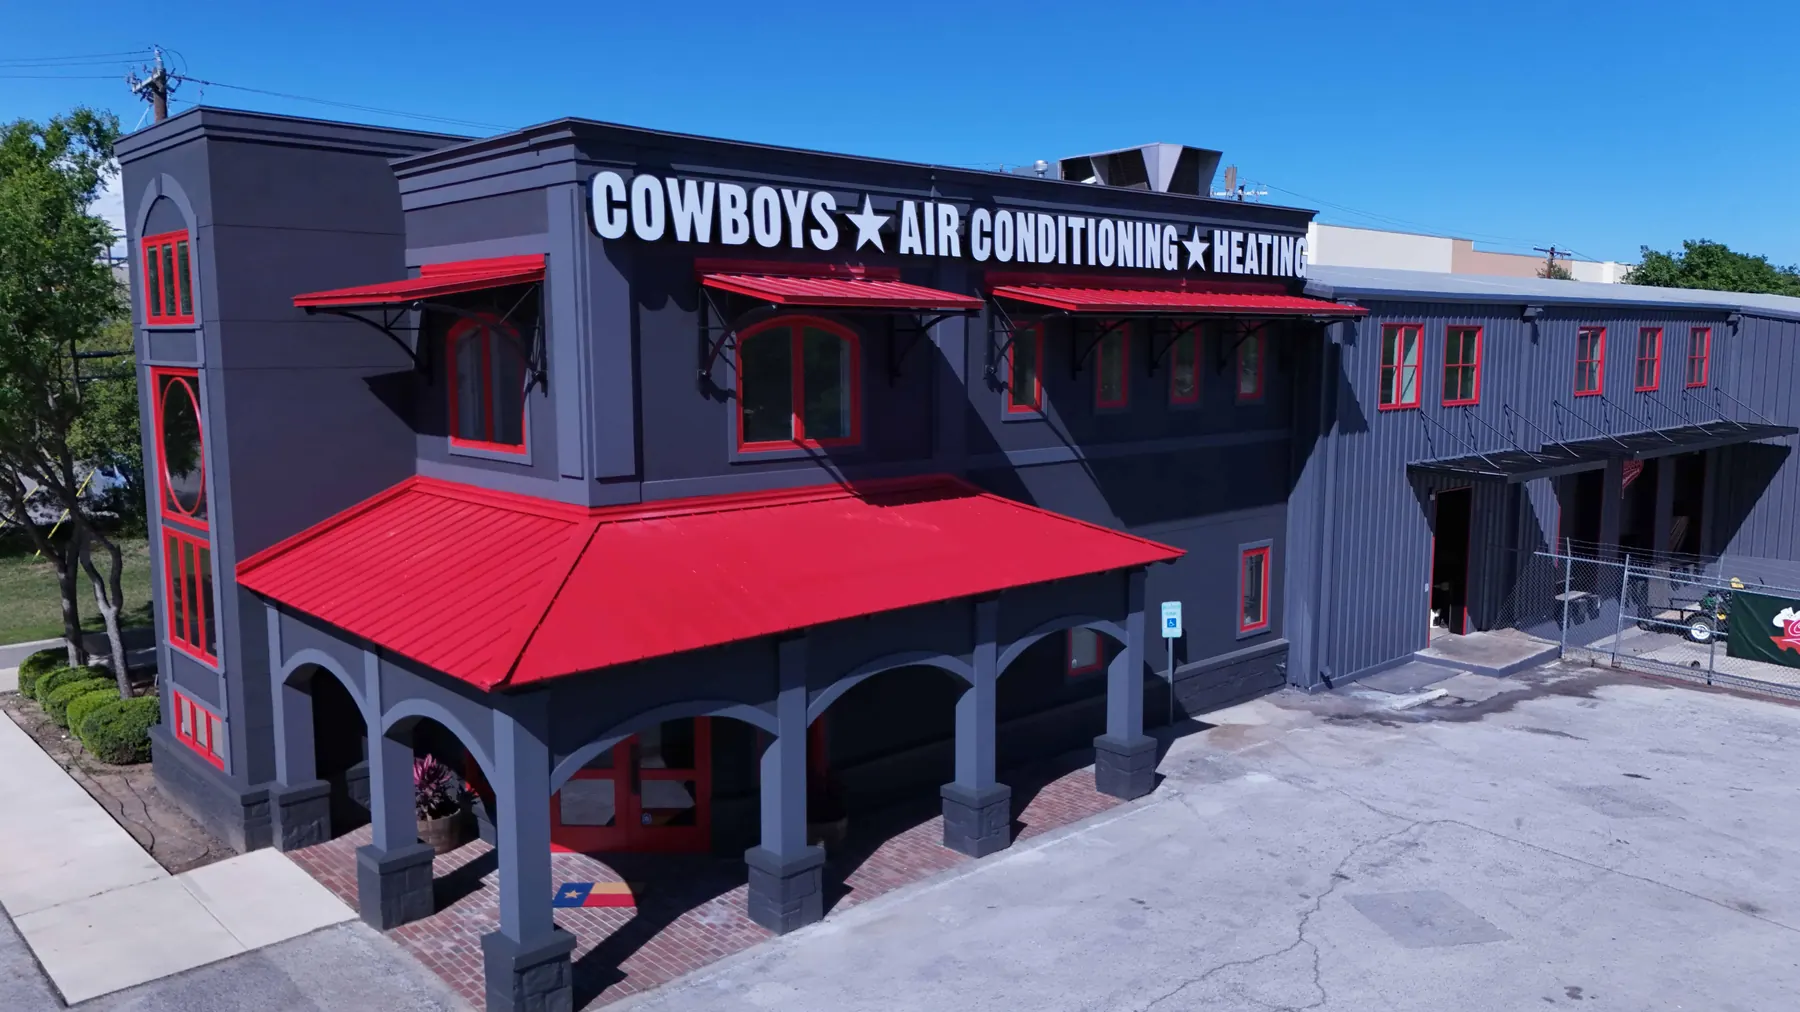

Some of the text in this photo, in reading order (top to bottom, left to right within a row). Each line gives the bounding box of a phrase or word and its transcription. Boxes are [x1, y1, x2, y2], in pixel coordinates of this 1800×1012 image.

[591, 171, 1308, 278] COWBOYS AIR CONDITIONING HEATING
